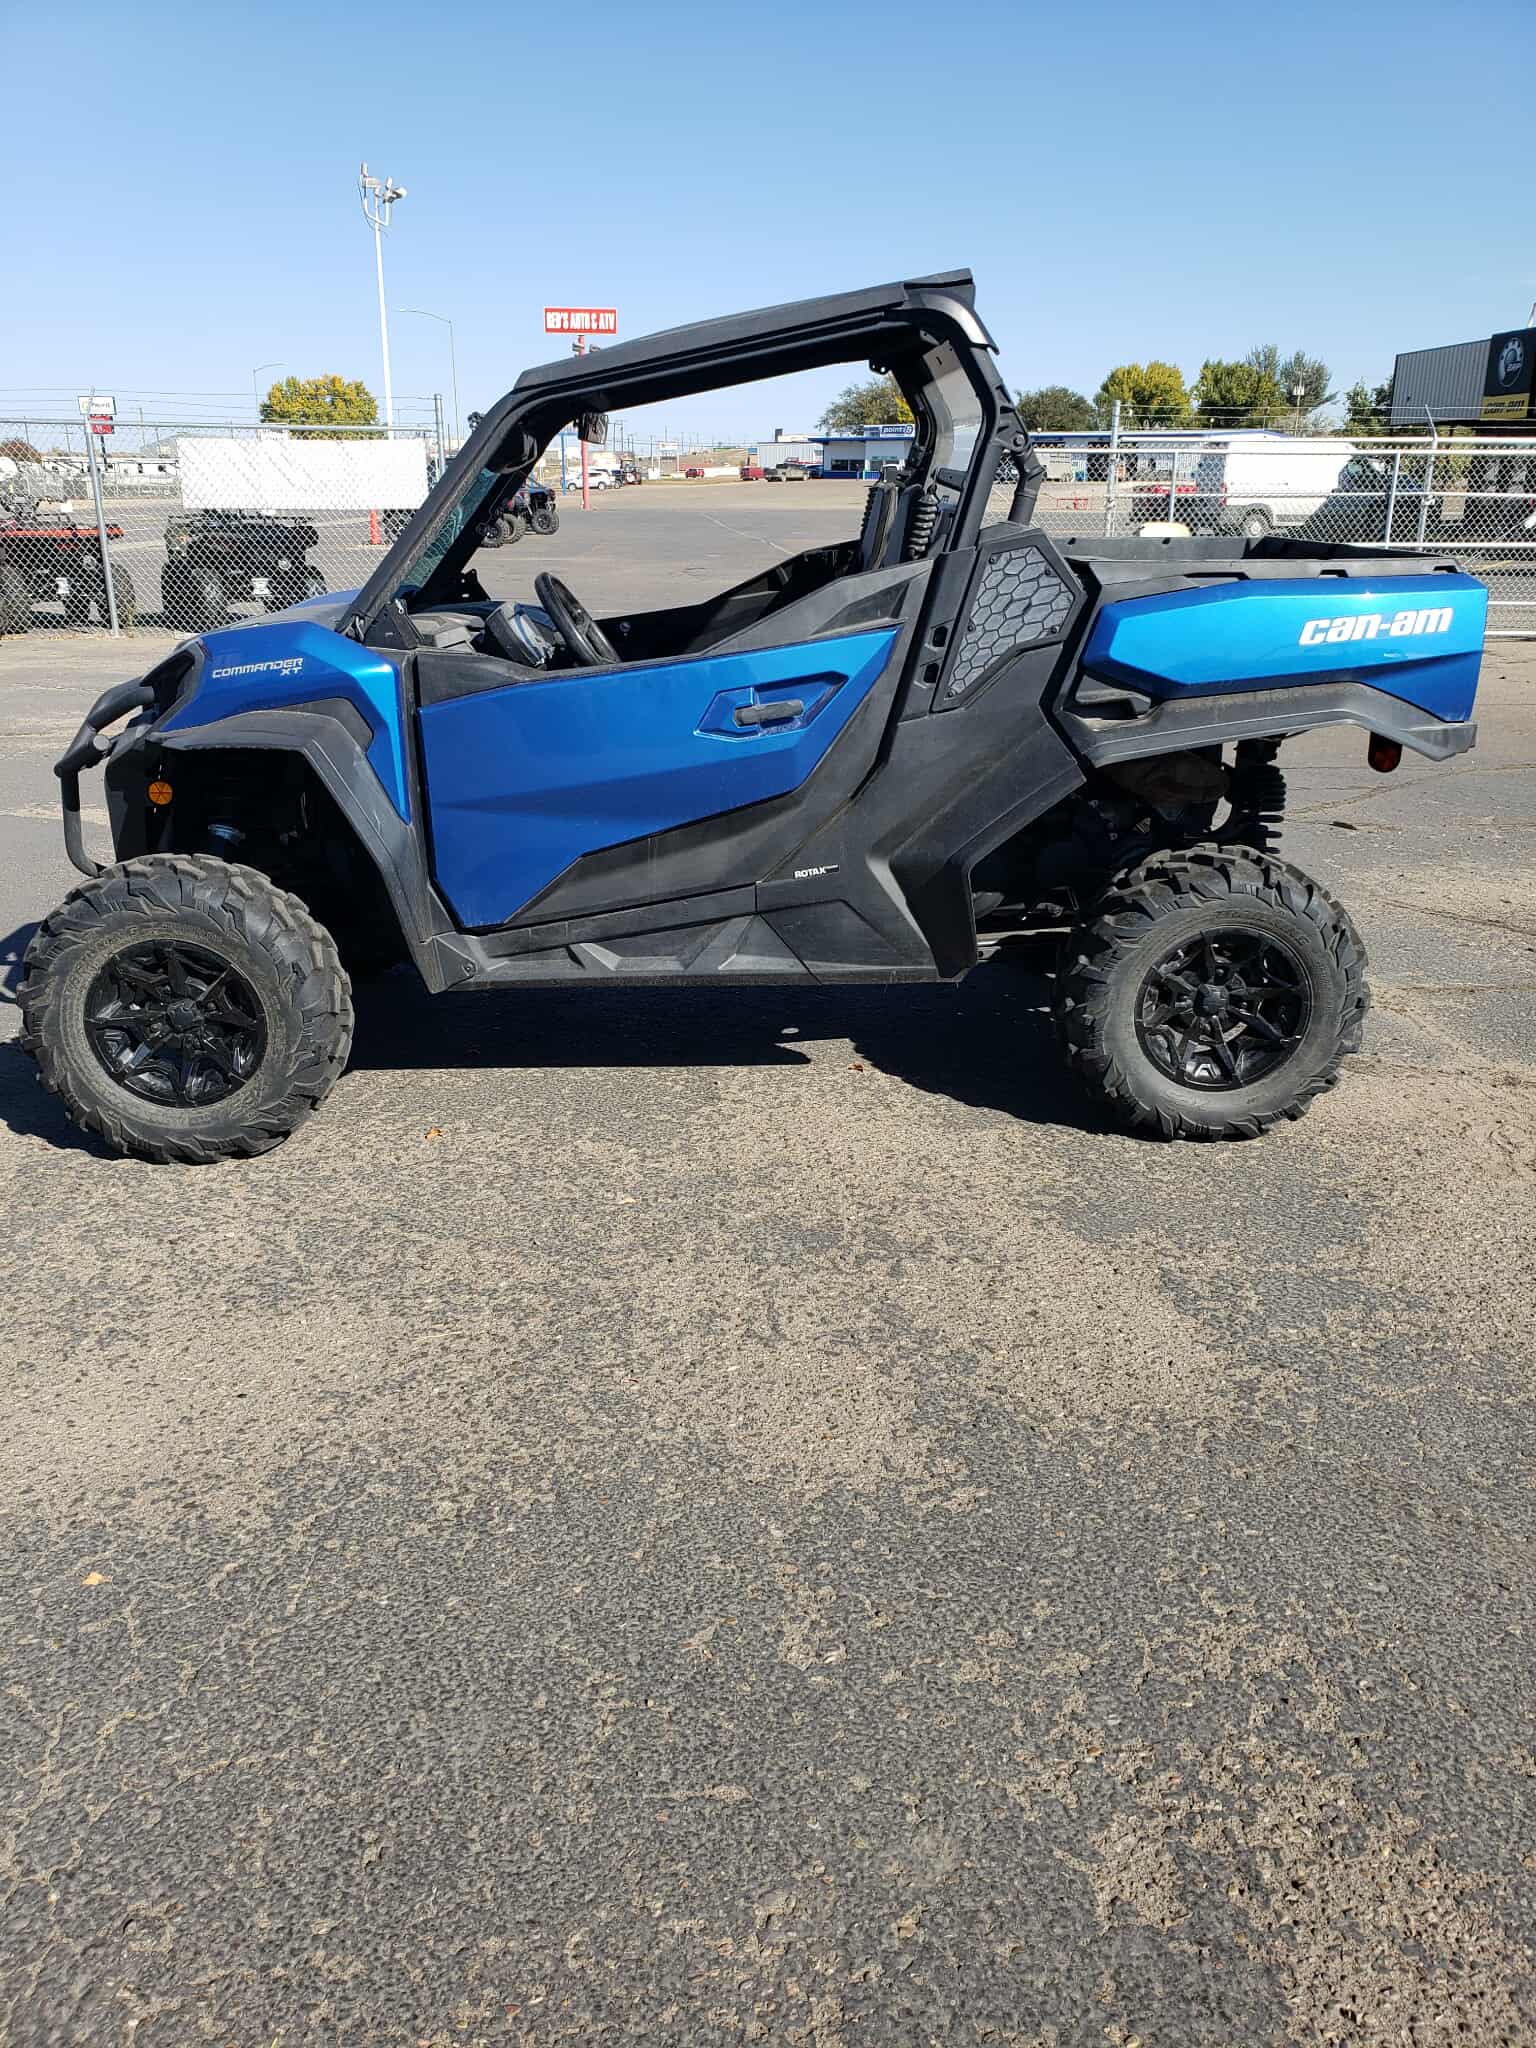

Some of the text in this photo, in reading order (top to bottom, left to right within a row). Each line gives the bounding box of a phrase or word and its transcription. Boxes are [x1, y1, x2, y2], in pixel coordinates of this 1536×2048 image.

[599, 313, 615, 330] ATV
[211, 657, 304, 679] COMMANDER
[280, 667, 303, 676] XT
[794, 866, 826, 878] ROTAX
